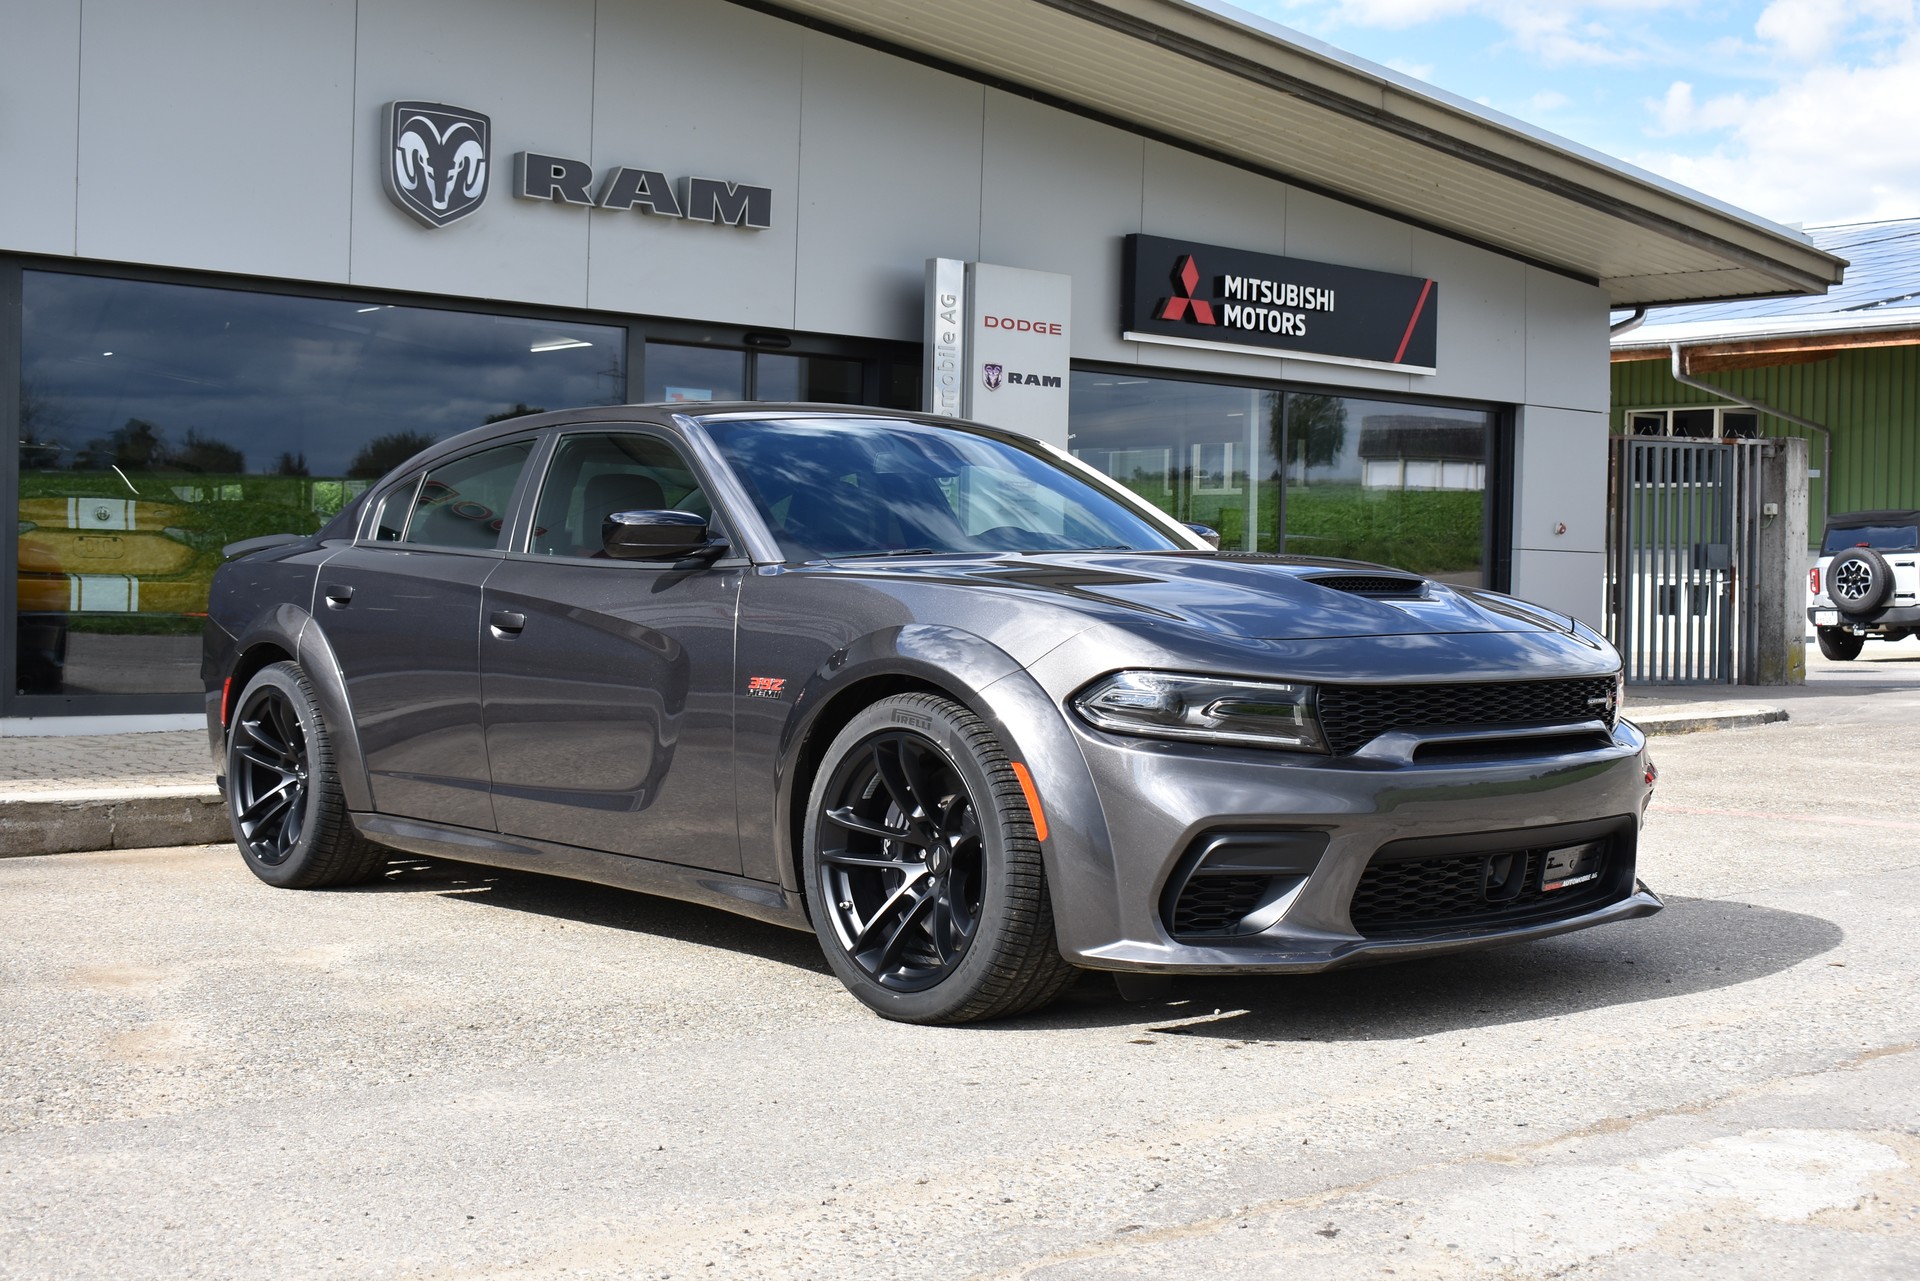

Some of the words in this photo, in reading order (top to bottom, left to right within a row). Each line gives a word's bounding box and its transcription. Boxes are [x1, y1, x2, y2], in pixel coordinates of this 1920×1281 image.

[514, 151, 772, 231] RAM
[1224, 275, 1334, 311] MITSUBISHI
[940, 294, 957, 325] AG
[1224, 304, 1306, 336] MOTORS
[984, 315, 1062, 335] DODGE
[1008, 372, 1061, 388] RAM
[746, 689, 781, 700] HEMI
[748, 677, 784, 691] 392
[890, 708, 933, 731] PIRELLI
